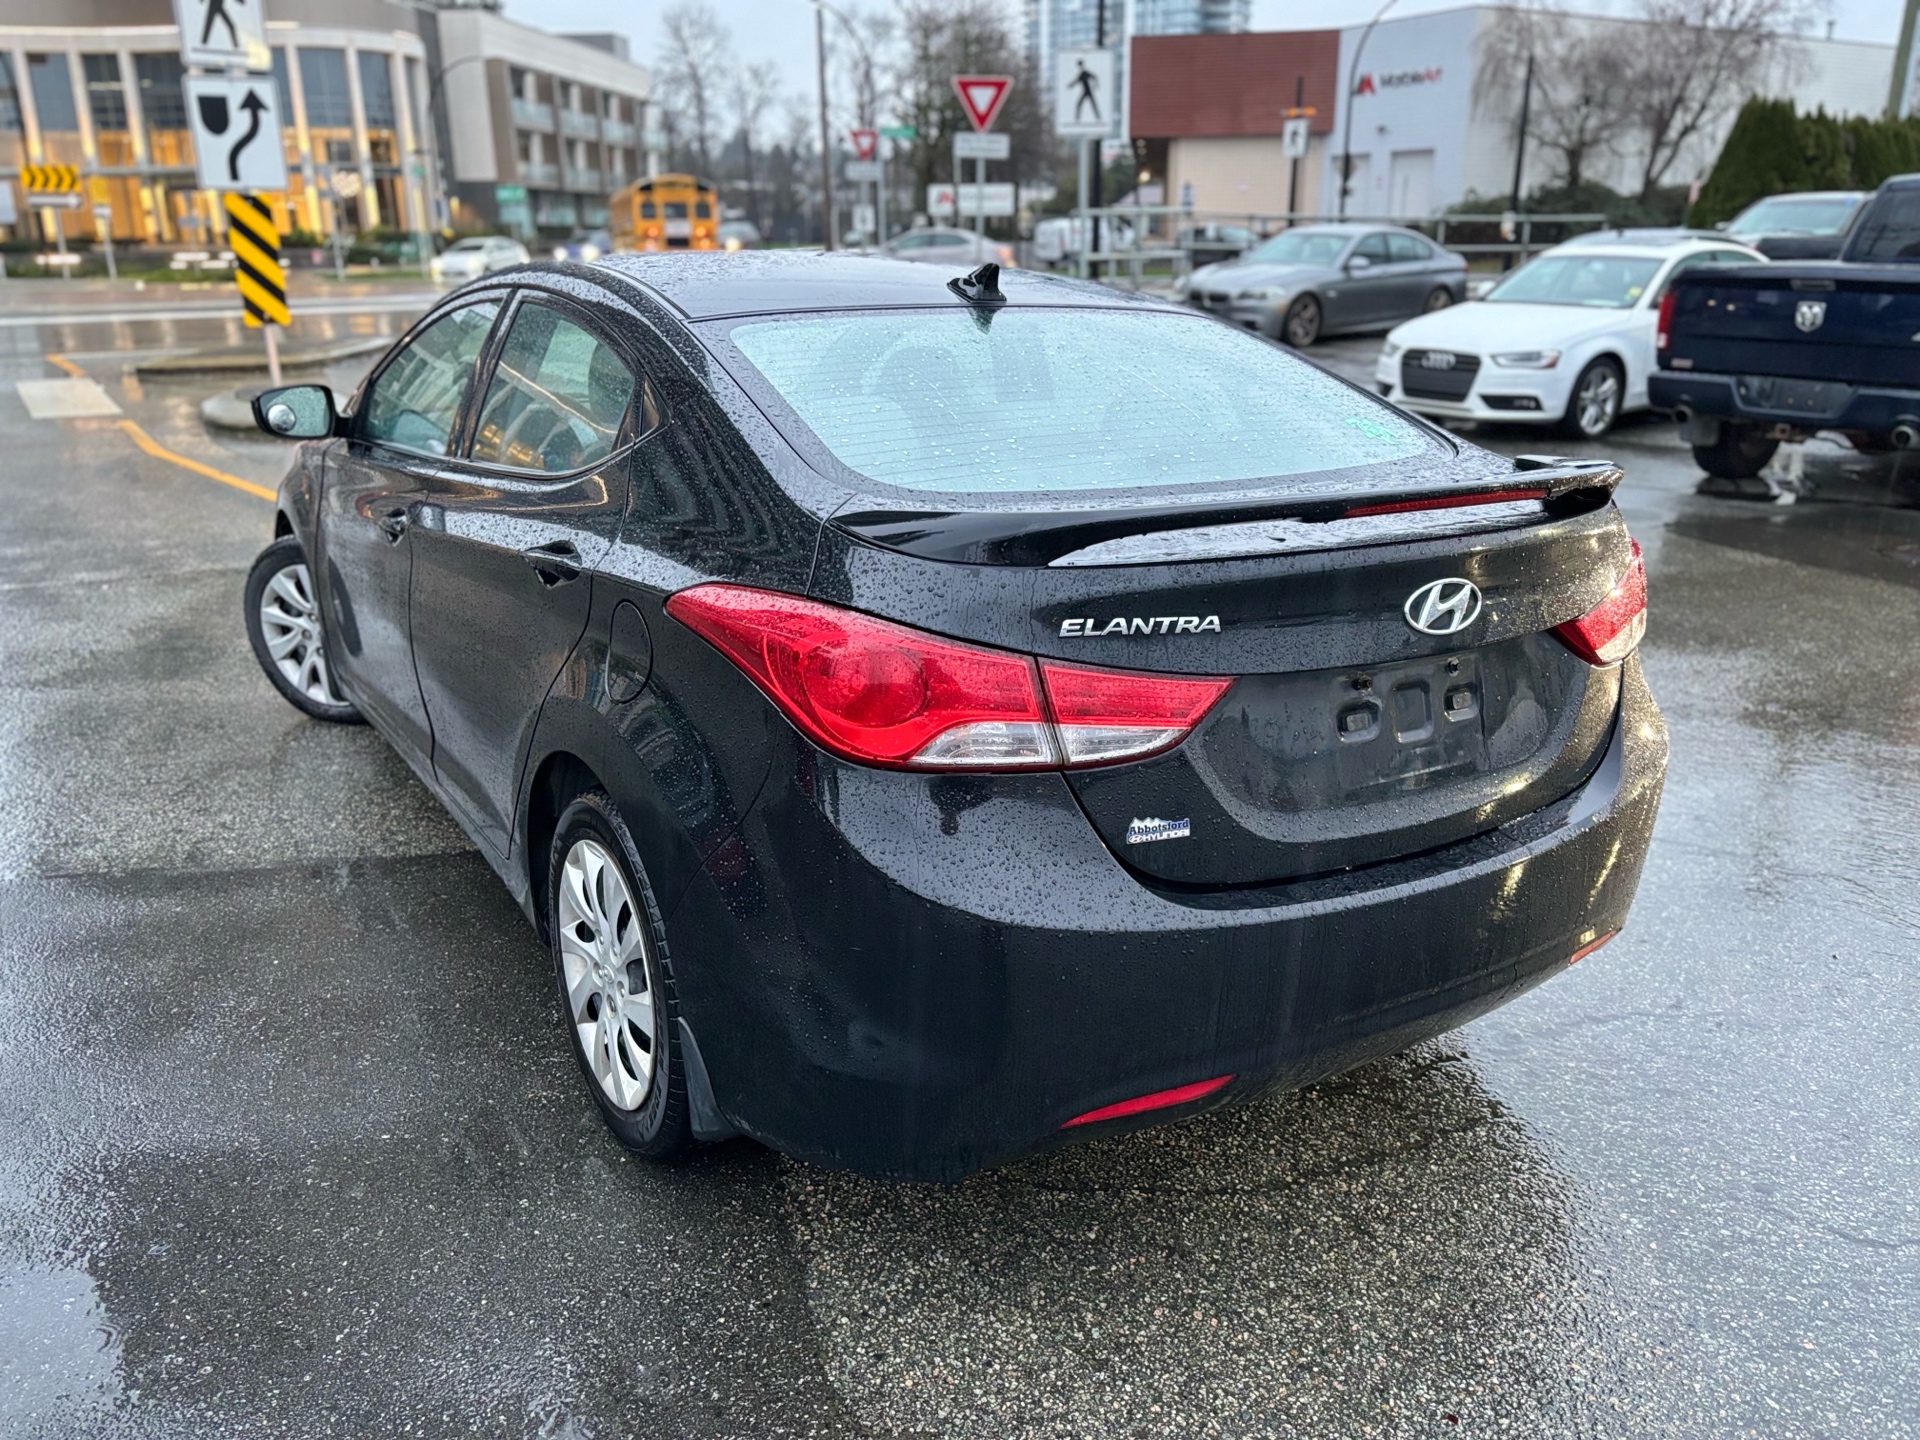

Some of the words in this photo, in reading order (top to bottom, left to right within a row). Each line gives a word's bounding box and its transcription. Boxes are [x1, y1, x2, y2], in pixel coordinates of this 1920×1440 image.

[1059, 615, 1222, 637] ELANTRA
[1129, 819, 1189, 835] Abbotsford
[1142, 828, 1190, 842] HYUNDAI
